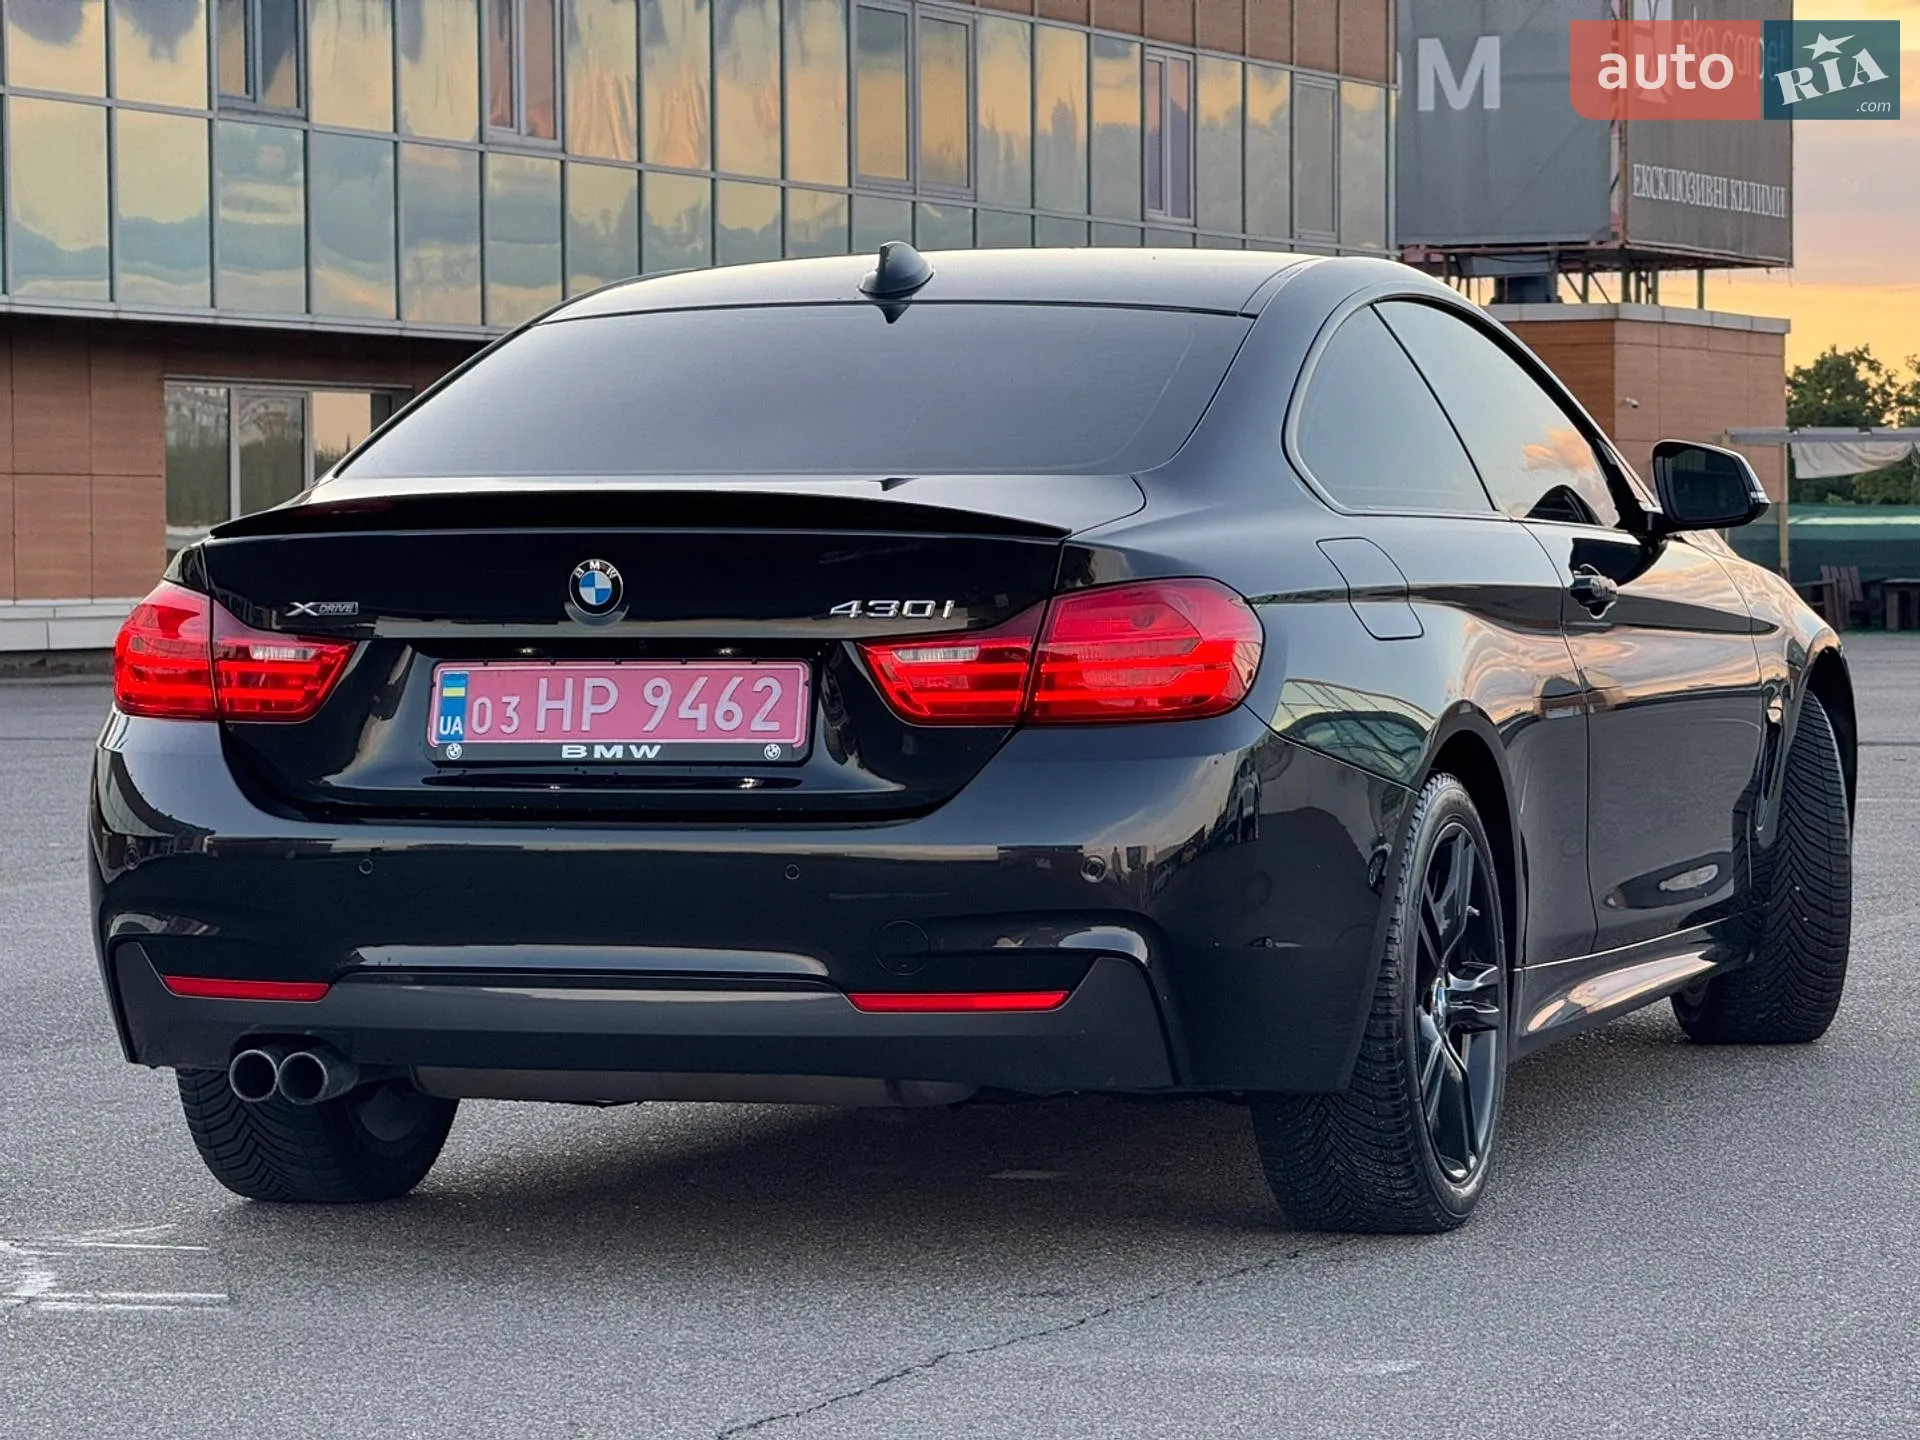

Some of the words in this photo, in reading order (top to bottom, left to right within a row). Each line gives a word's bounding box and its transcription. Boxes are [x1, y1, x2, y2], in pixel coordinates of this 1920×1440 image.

[1397, 36, 1501, 111] M
[1633, 163, 1728, 209] ЕКСКЛЮЗИВНІ
[1730, 179, 1787, 218] КИЛИМИ
[574, 560, 618, 579] BMW
[829, 599, 956, 619] 430i
[471, 696, 520, 735] 03
[535, 677, 619, 732] HP
[642, 676, 783, 732] 9462
[439, 716, 464, 736] UA
[561, 744, 662, 759] BMW
